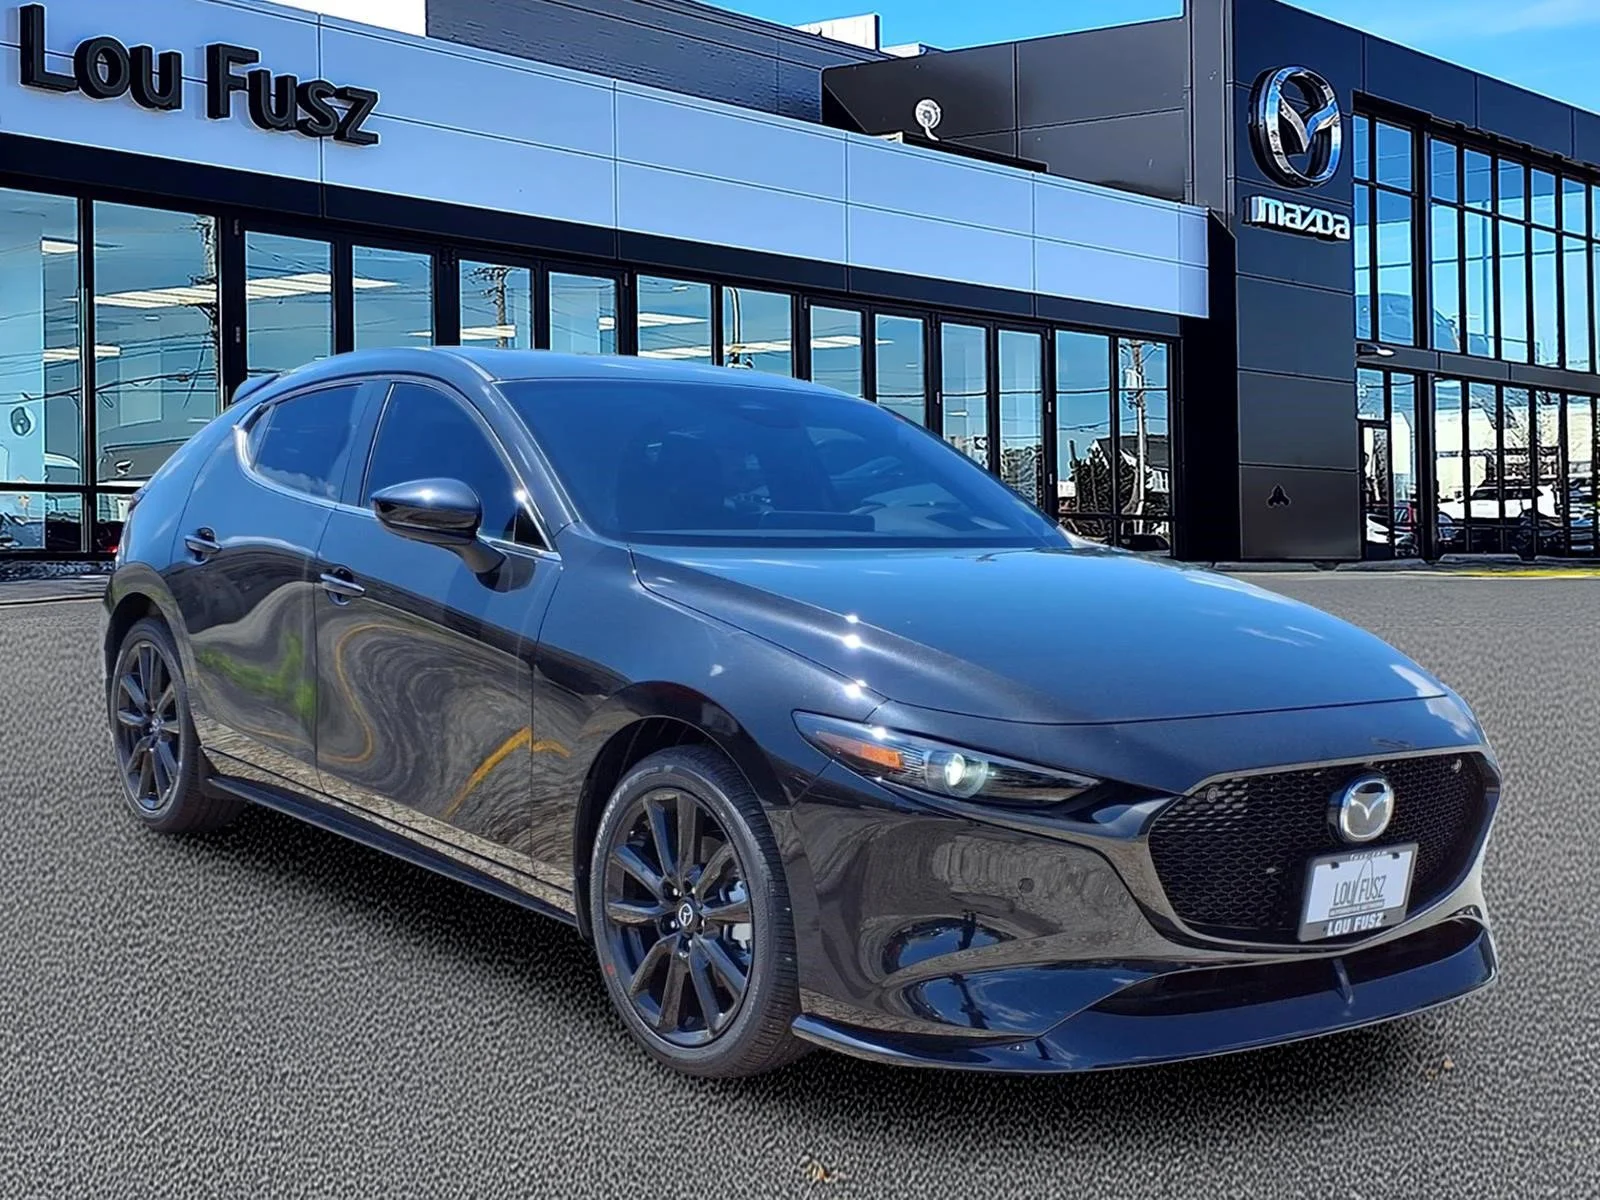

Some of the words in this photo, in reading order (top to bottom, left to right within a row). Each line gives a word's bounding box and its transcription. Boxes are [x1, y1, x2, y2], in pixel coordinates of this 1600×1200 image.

[20, 4, 181, 110] Lou
[207, 44, 379, 145] Fusz
[1333, 881, 1356, 906] LOU
[1359, 875, 1387, 901] FUSZ
[1327, 919, 1351, 936] LOU
[1353, 912, 1385, 931] FUSZ
